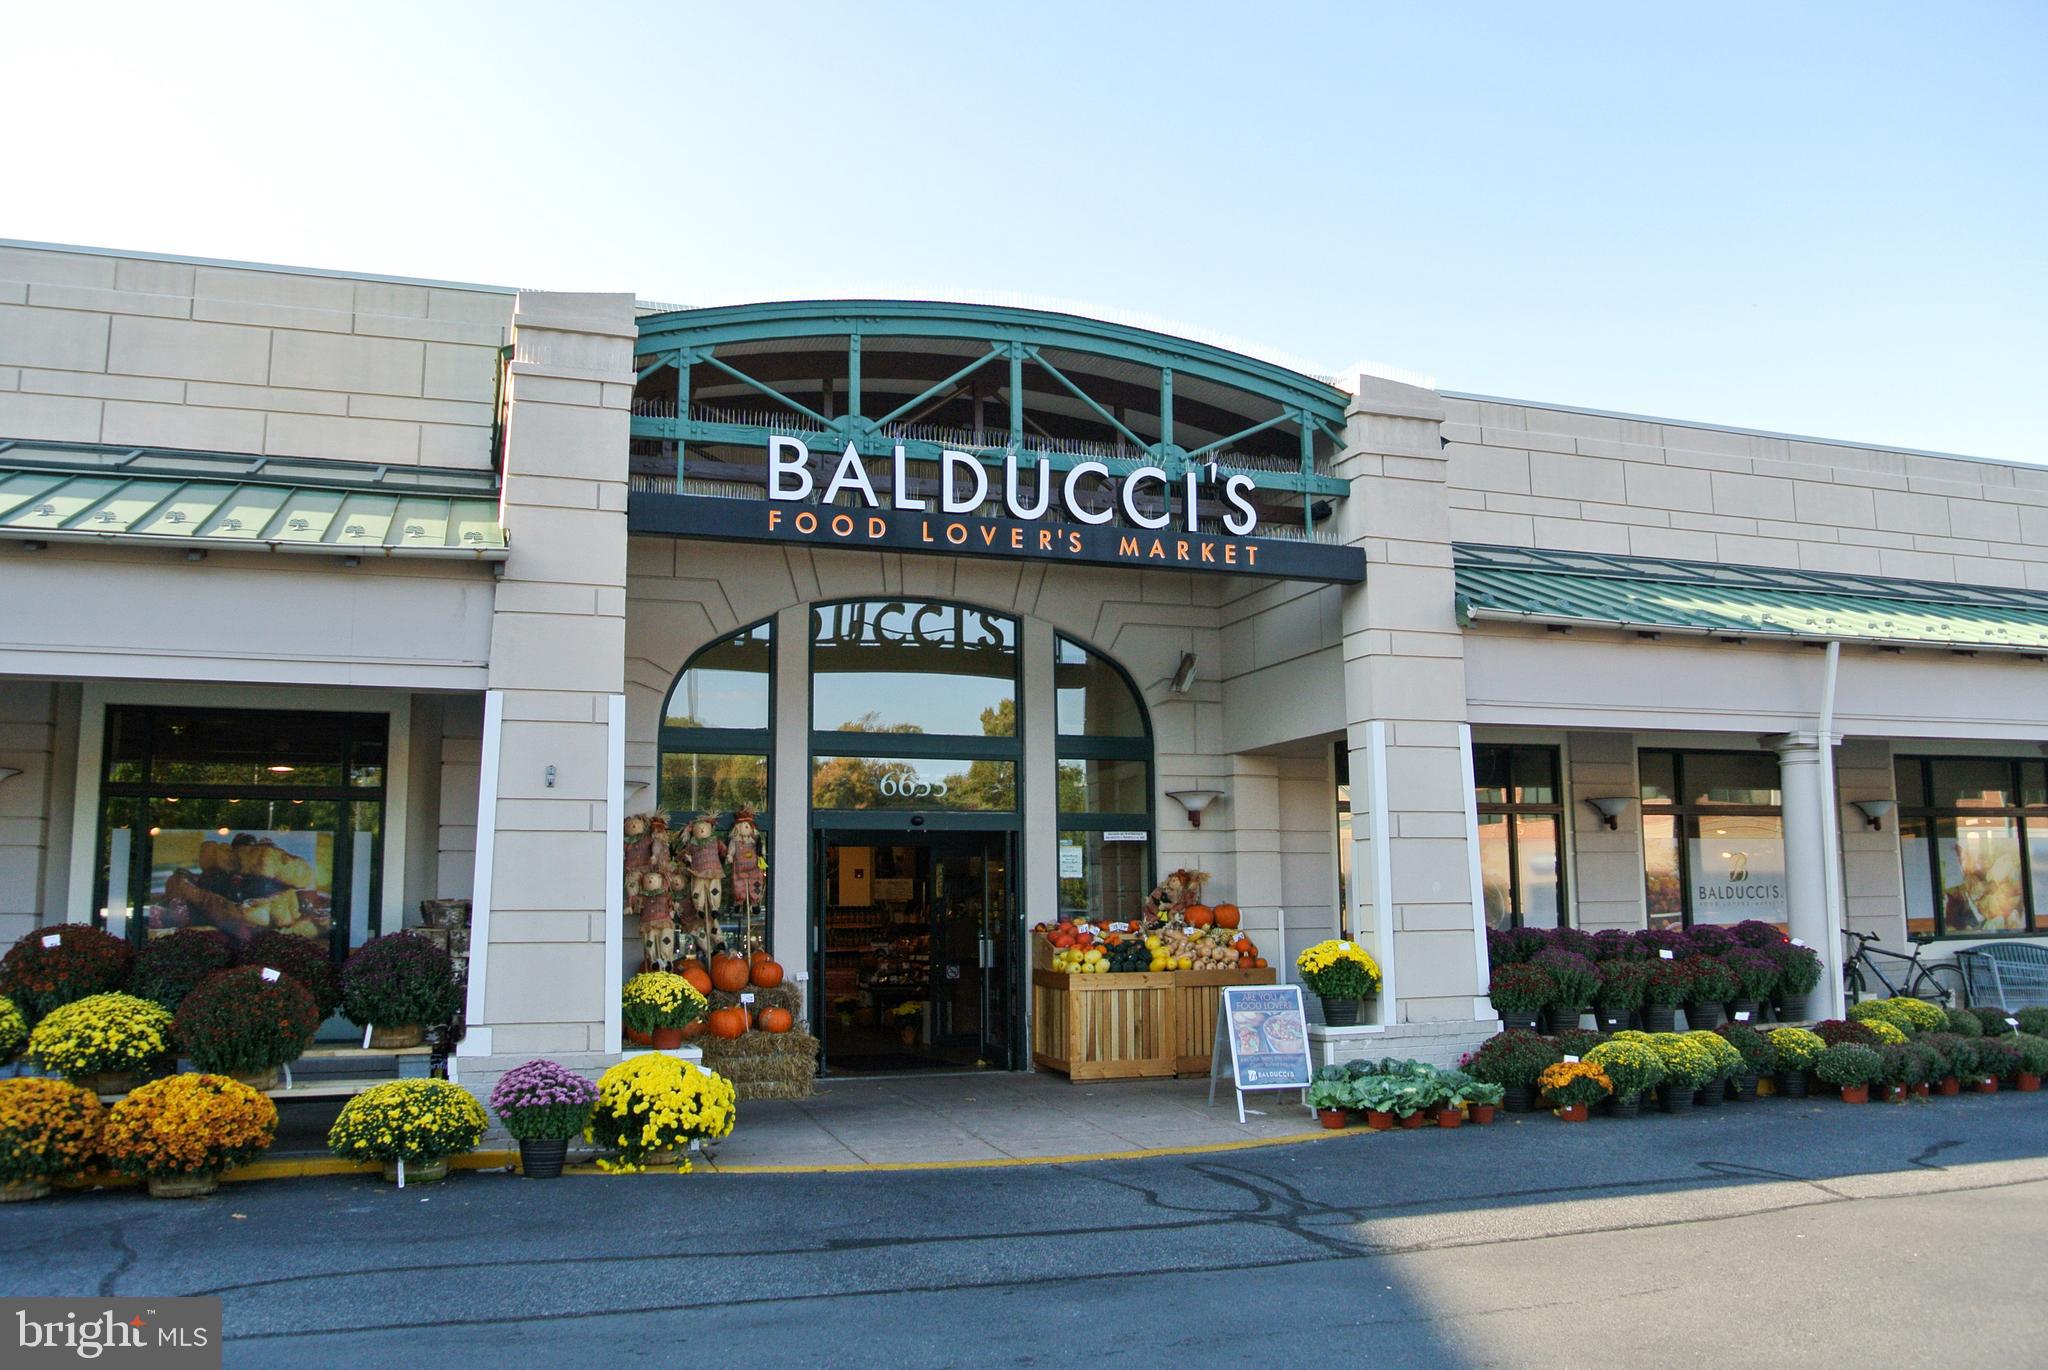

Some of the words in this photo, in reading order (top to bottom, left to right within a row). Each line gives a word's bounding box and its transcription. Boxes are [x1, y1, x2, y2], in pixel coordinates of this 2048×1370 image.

[769, 436, 1257, 535] BALDUCCI'S
[769, 510, 886, 538] FOOD
[922, 521, 1082, 552] LOVER'S
[1119, 536, 1258, 565] MARKET
[1236, 1001, 1261, 1010] FOOD
